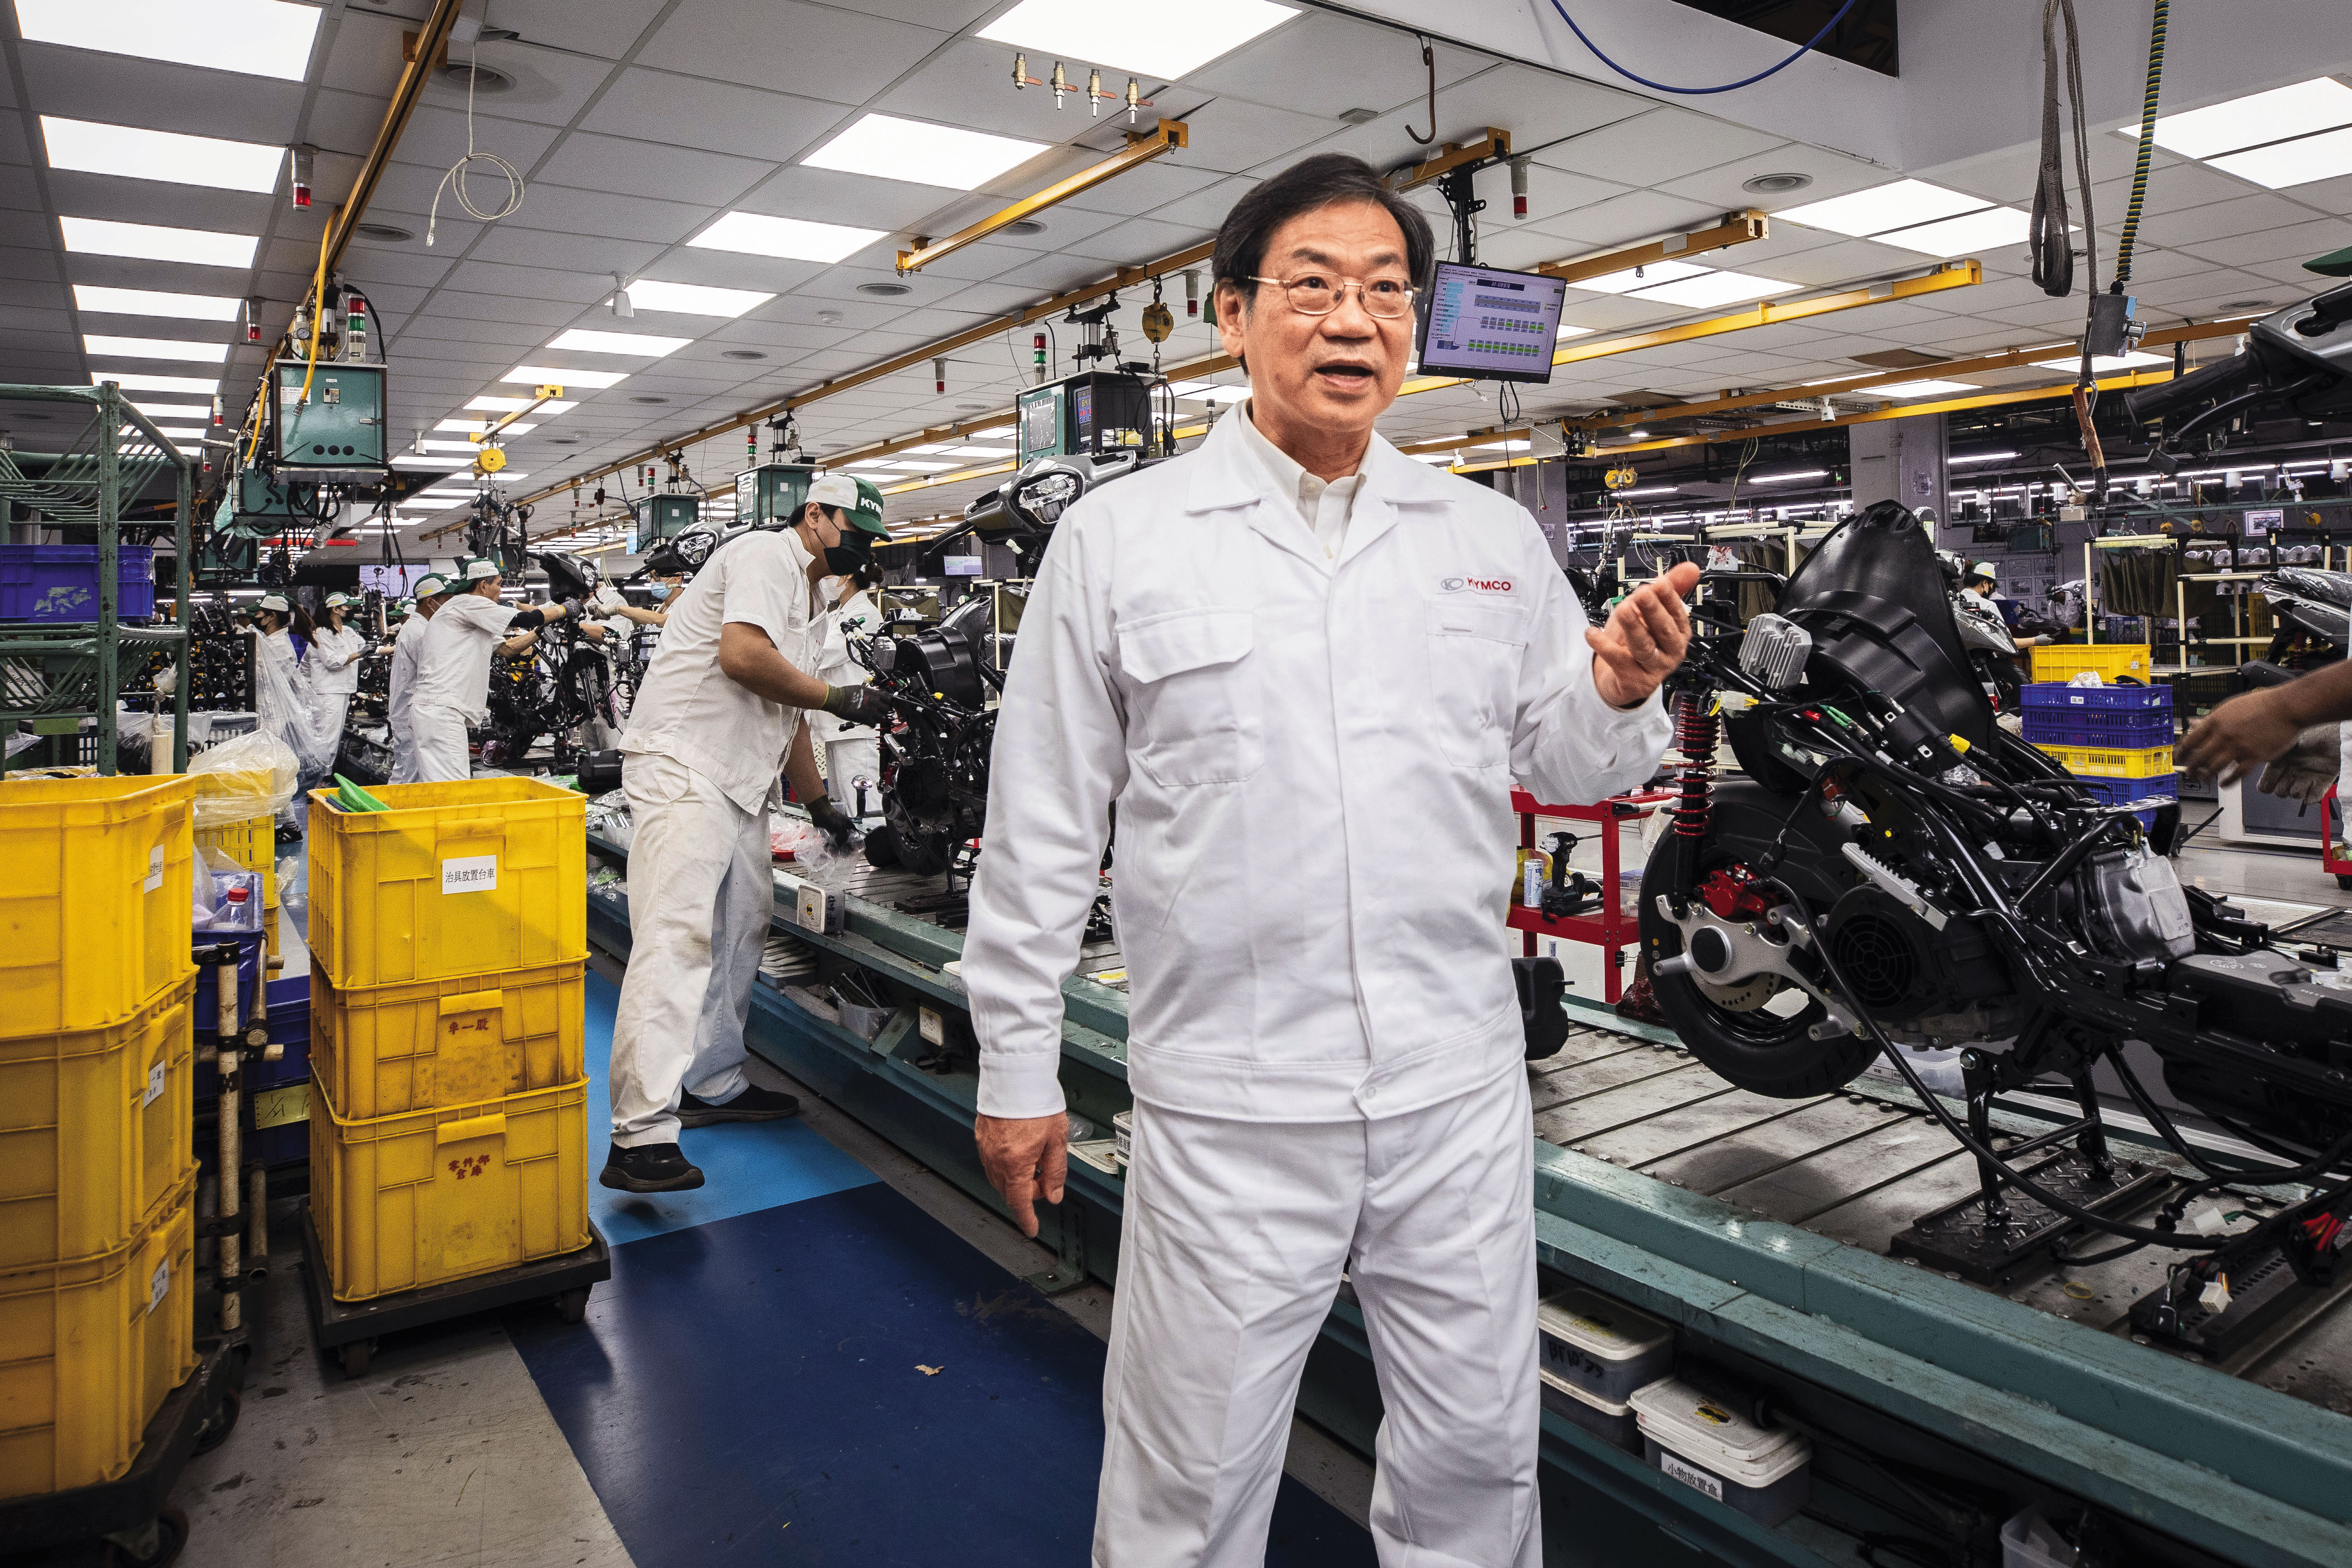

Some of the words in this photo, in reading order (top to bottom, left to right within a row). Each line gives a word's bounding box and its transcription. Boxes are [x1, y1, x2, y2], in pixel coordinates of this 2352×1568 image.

[861, 497, 882, 517] KYM
[1467, 577, 1511, 591] KYMCO
[446, 868, 495, 883] 治具放置台車
[1667, 1464, 1717, 1496] 小物放置盒
